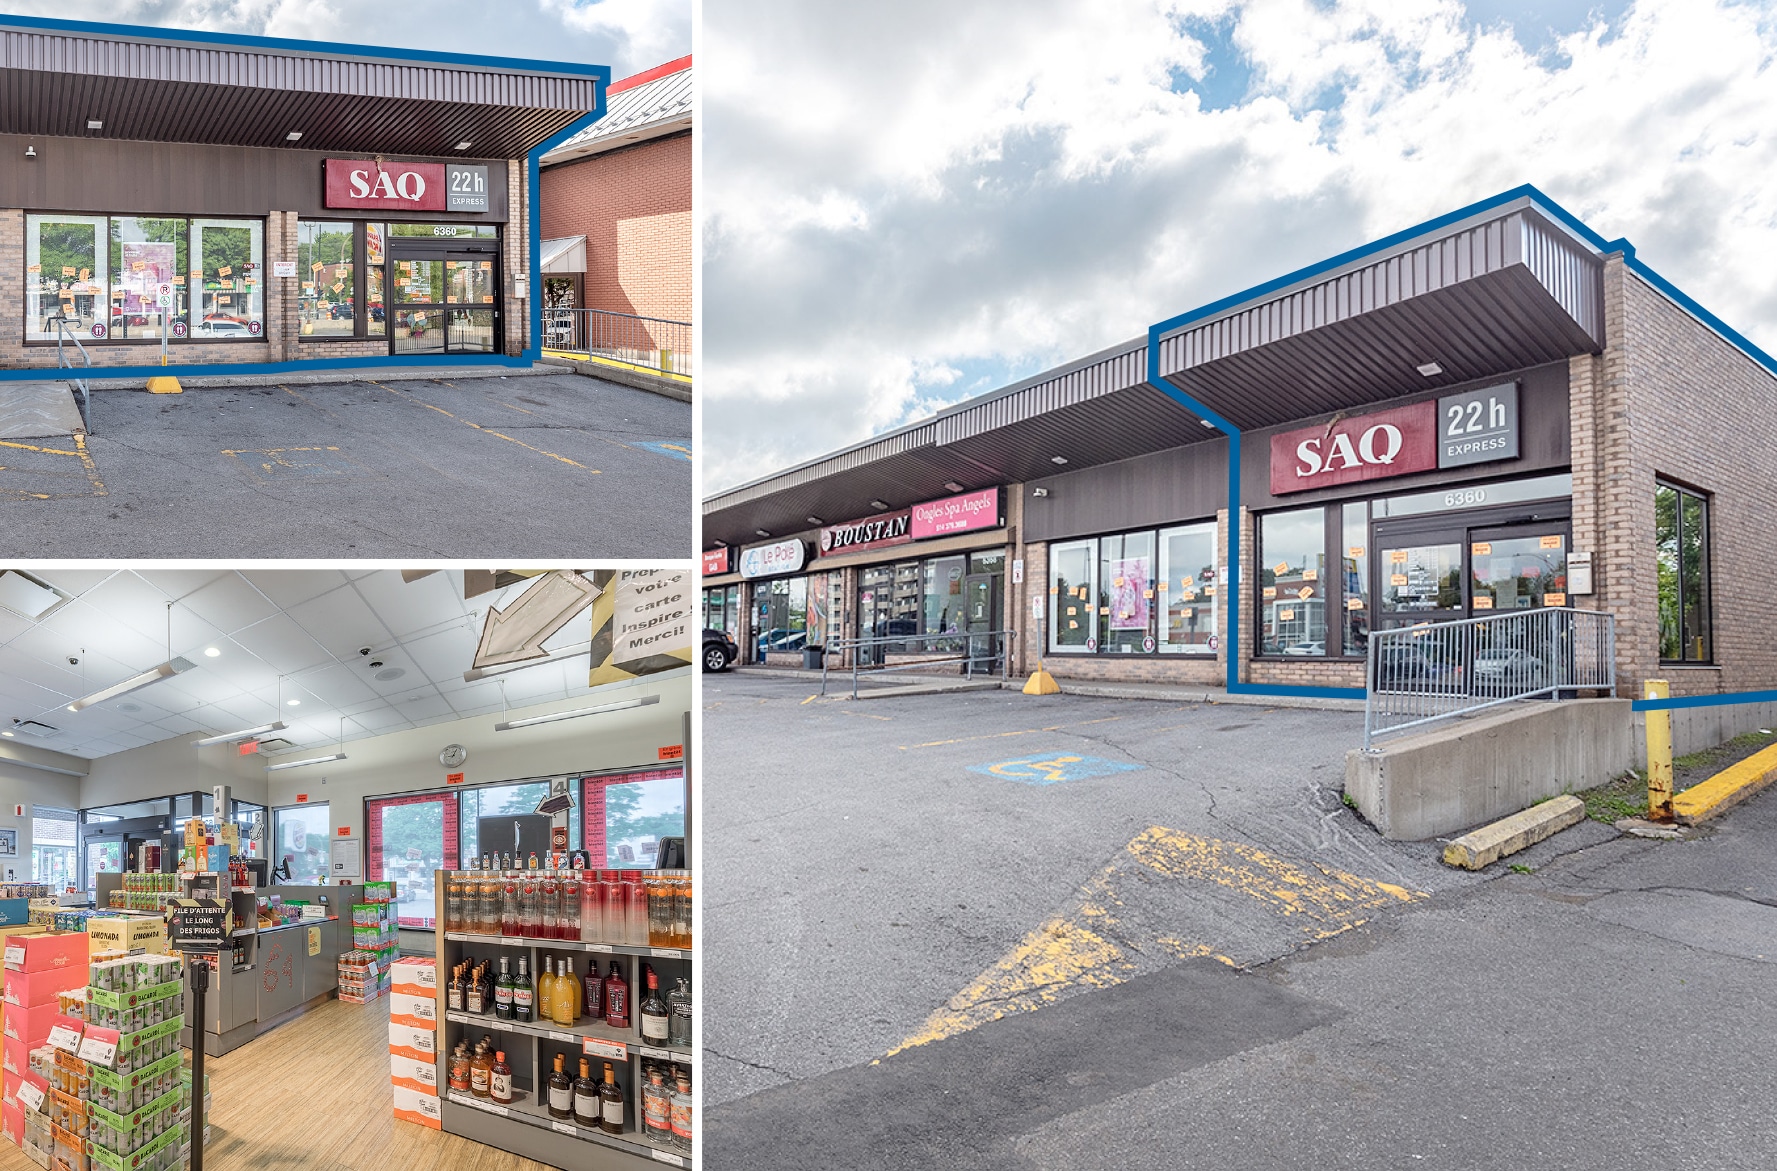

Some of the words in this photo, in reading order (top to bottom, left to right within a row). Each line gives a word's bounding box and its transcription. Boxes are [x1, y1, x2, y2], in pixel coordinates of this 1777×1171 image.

[350, 170, 426, 201] SAQ
[434, 226, 456, 236] 6360
[1296, 424, 1403, 478] SAQ
[1448, 438, 1506, 456] EXPRESS
[1445, 490, 1486, 506] 6360
[916, 504, 944, 524] Ongles
[944, 502, 960, 519] Spa
[962, 493, 991, 515] Angels
[834, 516, 908, 548] BOUSTAN
[764, 550, 773, 564] Le
[634, 593, 682, 614] carte
[622, 611, 683, 633] Inspire
[629, 625, 684, 649] Merci!
[214, 788, 220, 800] 1
[553, 781, 566, 793] 4
[254, 813, 260, 822] 2
[91, 931, 119, 941] LIMONADA
[133, 931, 159, 940] LIMONADA
